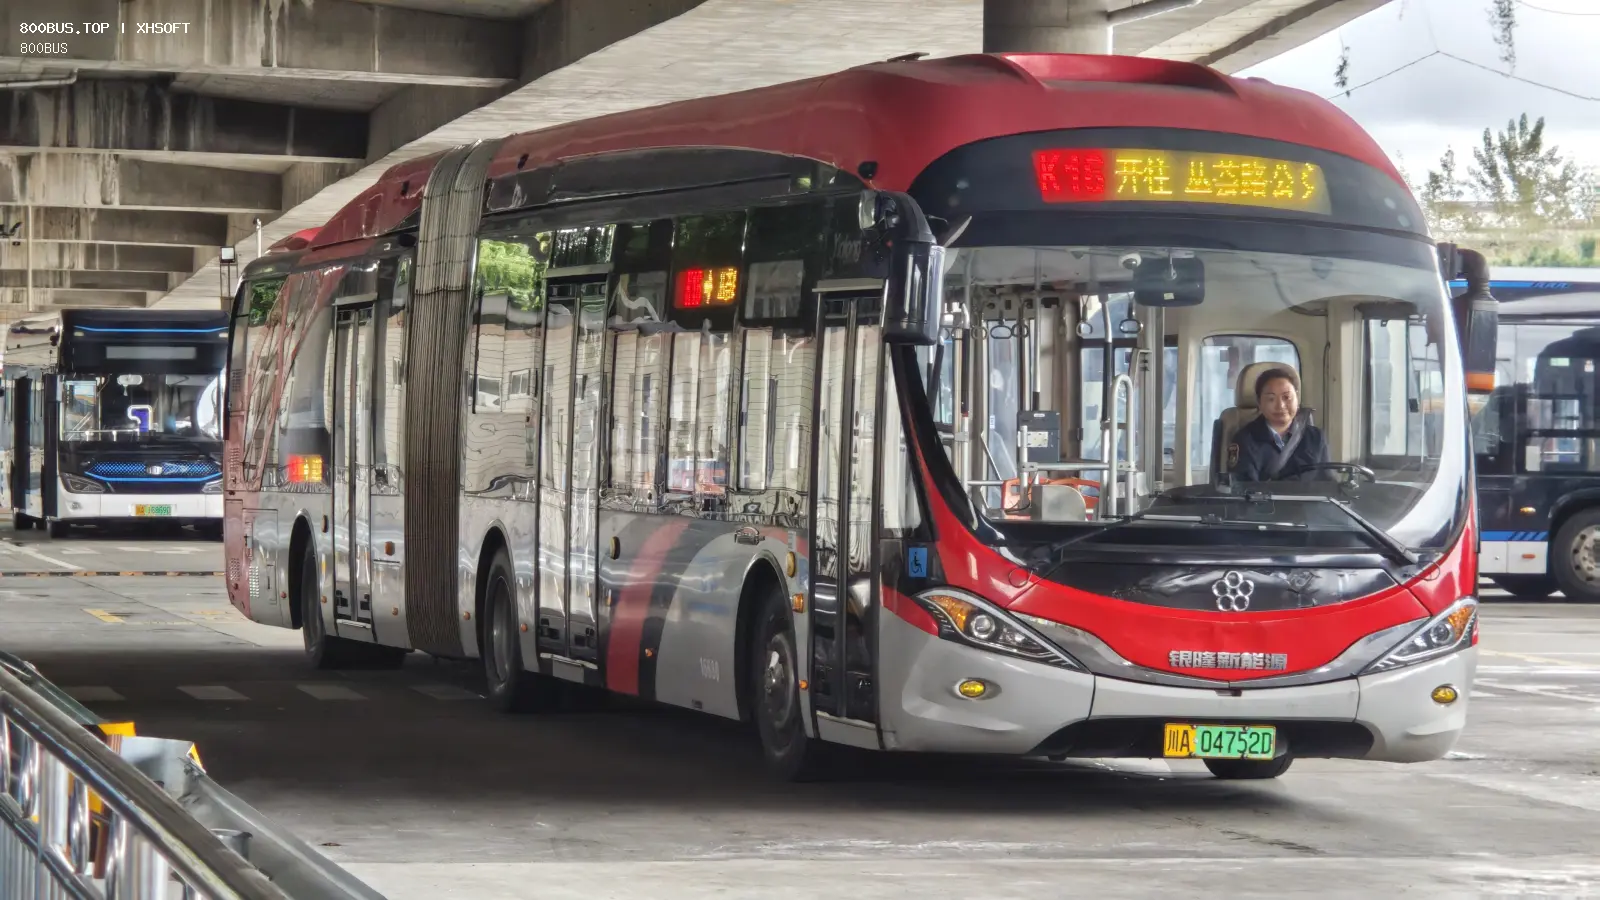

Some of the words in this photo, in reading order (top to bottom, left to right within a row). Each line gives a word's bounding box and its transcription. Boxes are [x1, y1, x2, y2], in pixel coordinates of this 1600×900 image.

[1168, 650, 1288, 670] 银隆新能源
